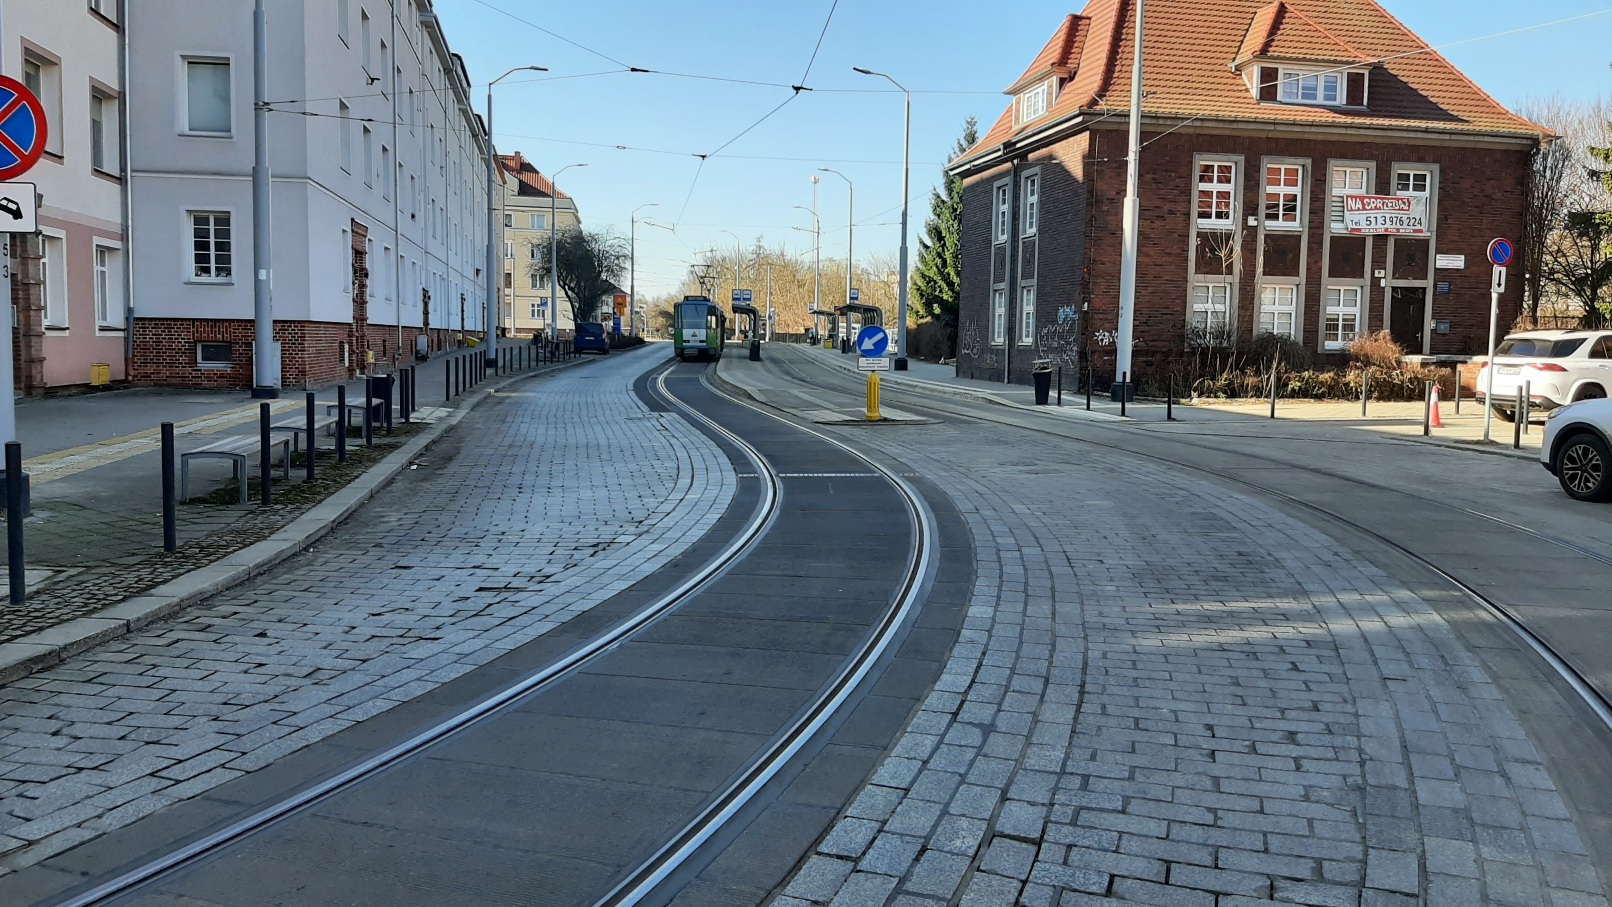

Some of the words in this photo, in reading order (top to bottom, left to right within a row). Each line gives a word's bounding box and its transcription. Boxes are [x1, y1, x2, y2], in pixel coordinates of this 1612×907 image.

[1348, 197, 1362, 210] NA
[1389, 216, 1404, 227] 976
[1406, 216, 1422, 227] 224
